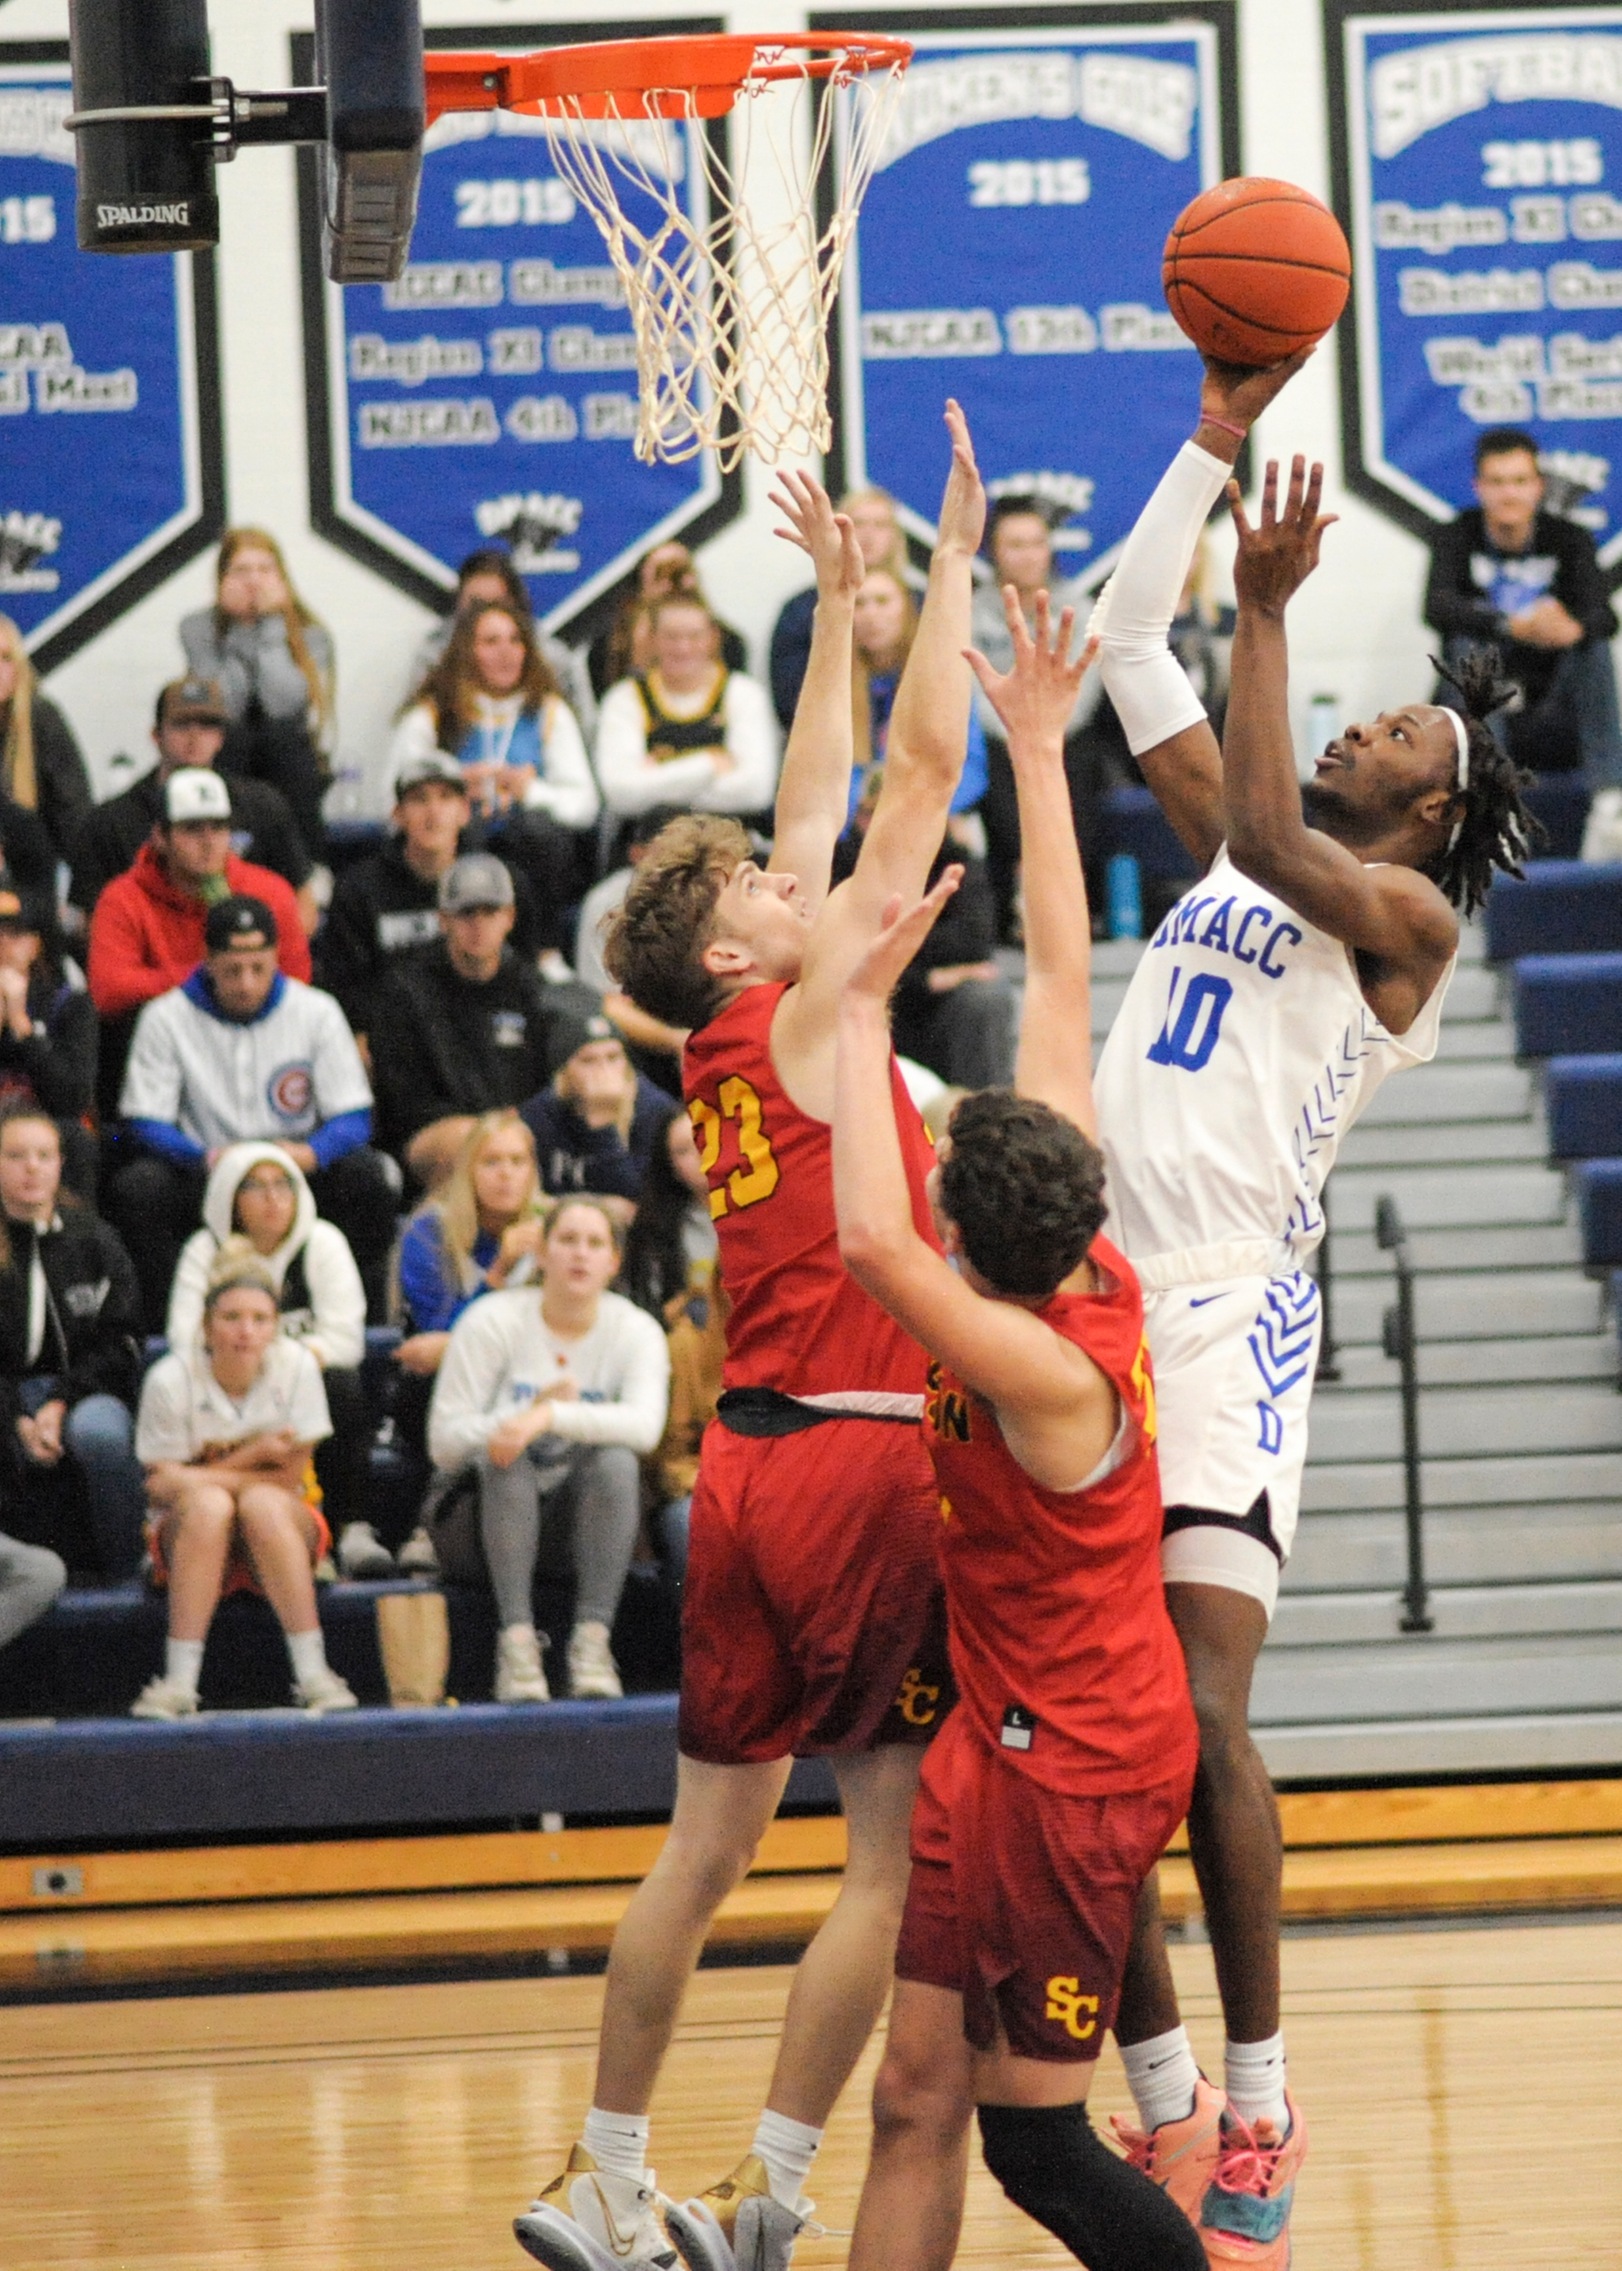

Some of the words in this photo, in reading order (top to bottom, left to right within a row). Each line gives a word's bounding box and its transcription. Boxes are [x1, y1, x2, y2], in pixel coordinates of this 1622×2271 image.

[970, 159, 1089, 207] 2015
[1482, 140, 1601, 187] 2015
[97, 202, 190, 228] SPALDING
[456, 179, 576, 227] 2015
[361, 399, 498, 447] NJCAA
[1146, 966, 1233, 1072] 10
[688, 1073, 779, 1220] 23
[1046, 1975, 1099, 2039] SC
